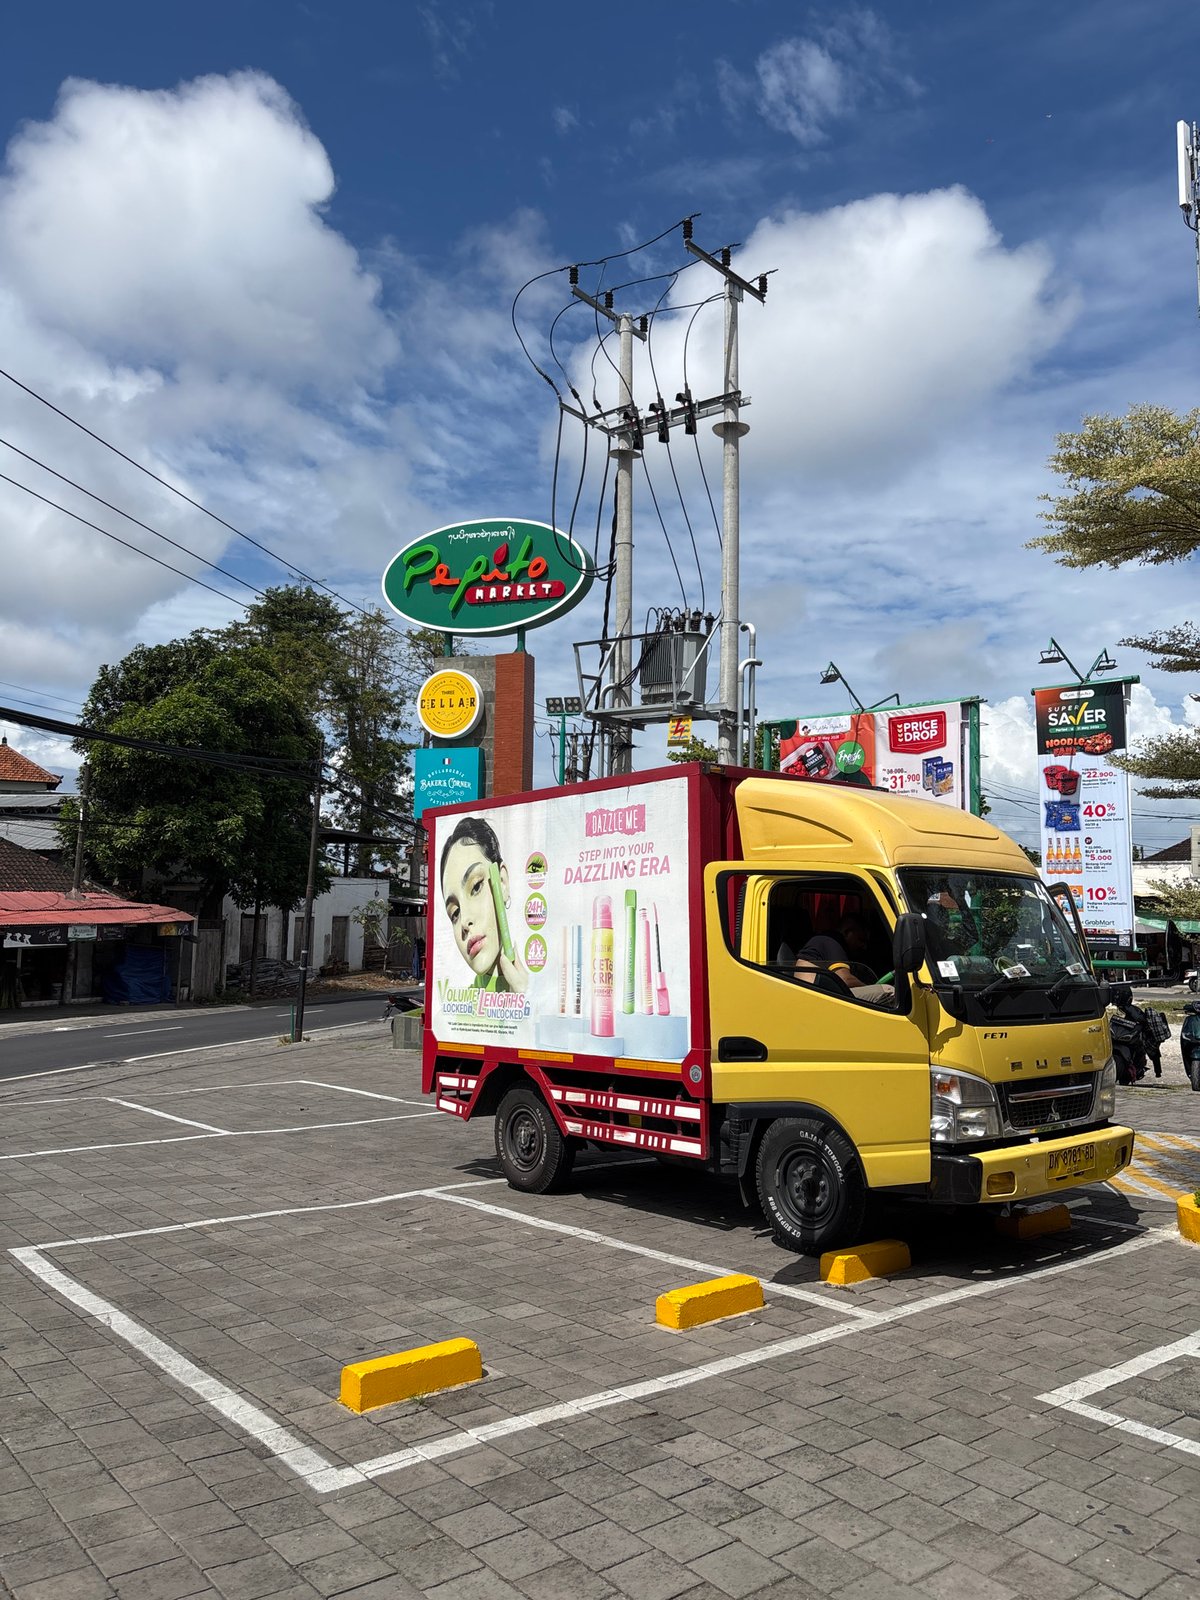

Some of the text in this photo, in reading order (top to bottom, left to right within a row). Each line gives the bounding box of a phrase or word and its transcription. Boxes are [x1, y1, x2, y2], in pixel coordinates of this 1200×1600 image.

[402, 534, 549, 612] Pepito
[475, 583, 552, 600] MARKET
[420, 697, 476, 709] CELLAR
[1047, 704, 1079, 713] SUPER
[903, 719, 938, 731] PRICE
[903, 729, 937, 742] DROP
[1046, 738, 1085, 748] NOODLE
[805, 754, 823, 768] TOMATO
[837, 747, 863, 764] Fresh
[447, 777, 472, 789] CORNER
[592, 809, 639, 834] DAZZLE ME
[579, 842, 654, 863] STEP INTO YOUR
[563, 855, 671, 885] DAZZLING ERA
[527, 901, 543, 913] 24H
[437, 978, 525, 1015] VOLUME LENGTHS
[443, 1003, 524, 1020] LOCKED UNLOCKED
[799, 1130, 846, 1185] GAJAH TUNGGAL
[1049, 1152, 1060, 1169] DK
[774, 1210, 793, 1234] SUPER
